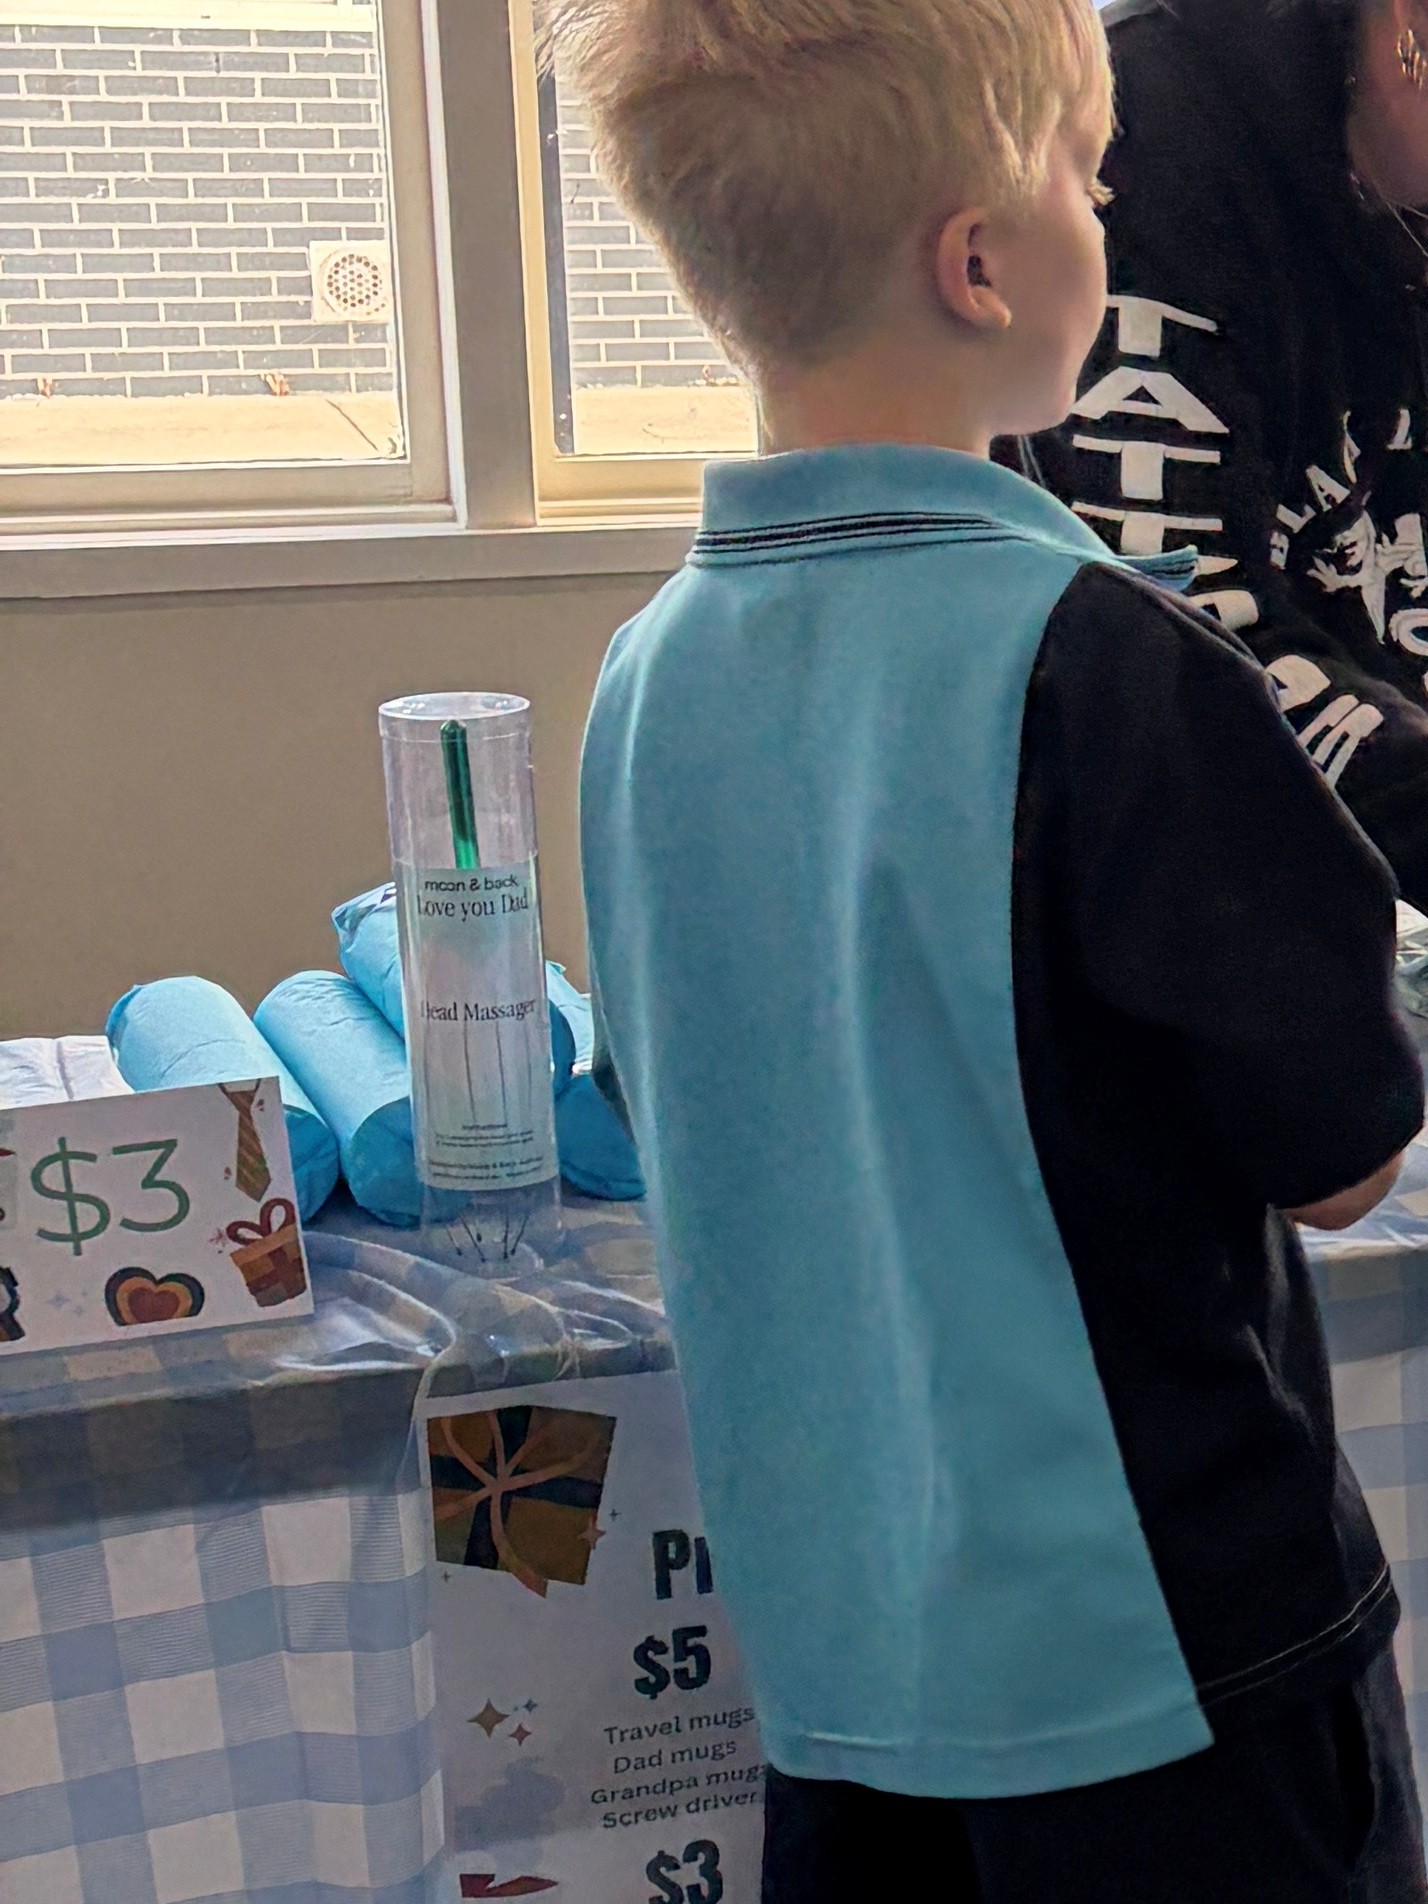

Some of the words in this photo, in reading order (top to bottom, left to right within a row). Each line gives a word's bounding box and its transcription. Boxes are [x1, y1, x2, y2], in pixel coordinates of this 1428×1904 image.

[425, 880, 466, 892] moon
[484, 874, 519, 890] back
[416, 894, 455, 917] Love
[460, 900, 495, 922] you
[501, 886, 529, 913] Dad
[463, 998, 536, 1021] Massager
[30, 1136, 191, 1256] $3
[633, 1625, 712, 1699] $5
[604, 1715, 681, 1745] Travel
[689, 1706, 755, 1732] mugs
[614, 1749, 663, 1774] Dad
[669, 1738, 737, 1763] mugs
[591, 1772, 698, 1804] Grandpa
[603, 1802, 679, 1828] Screw
